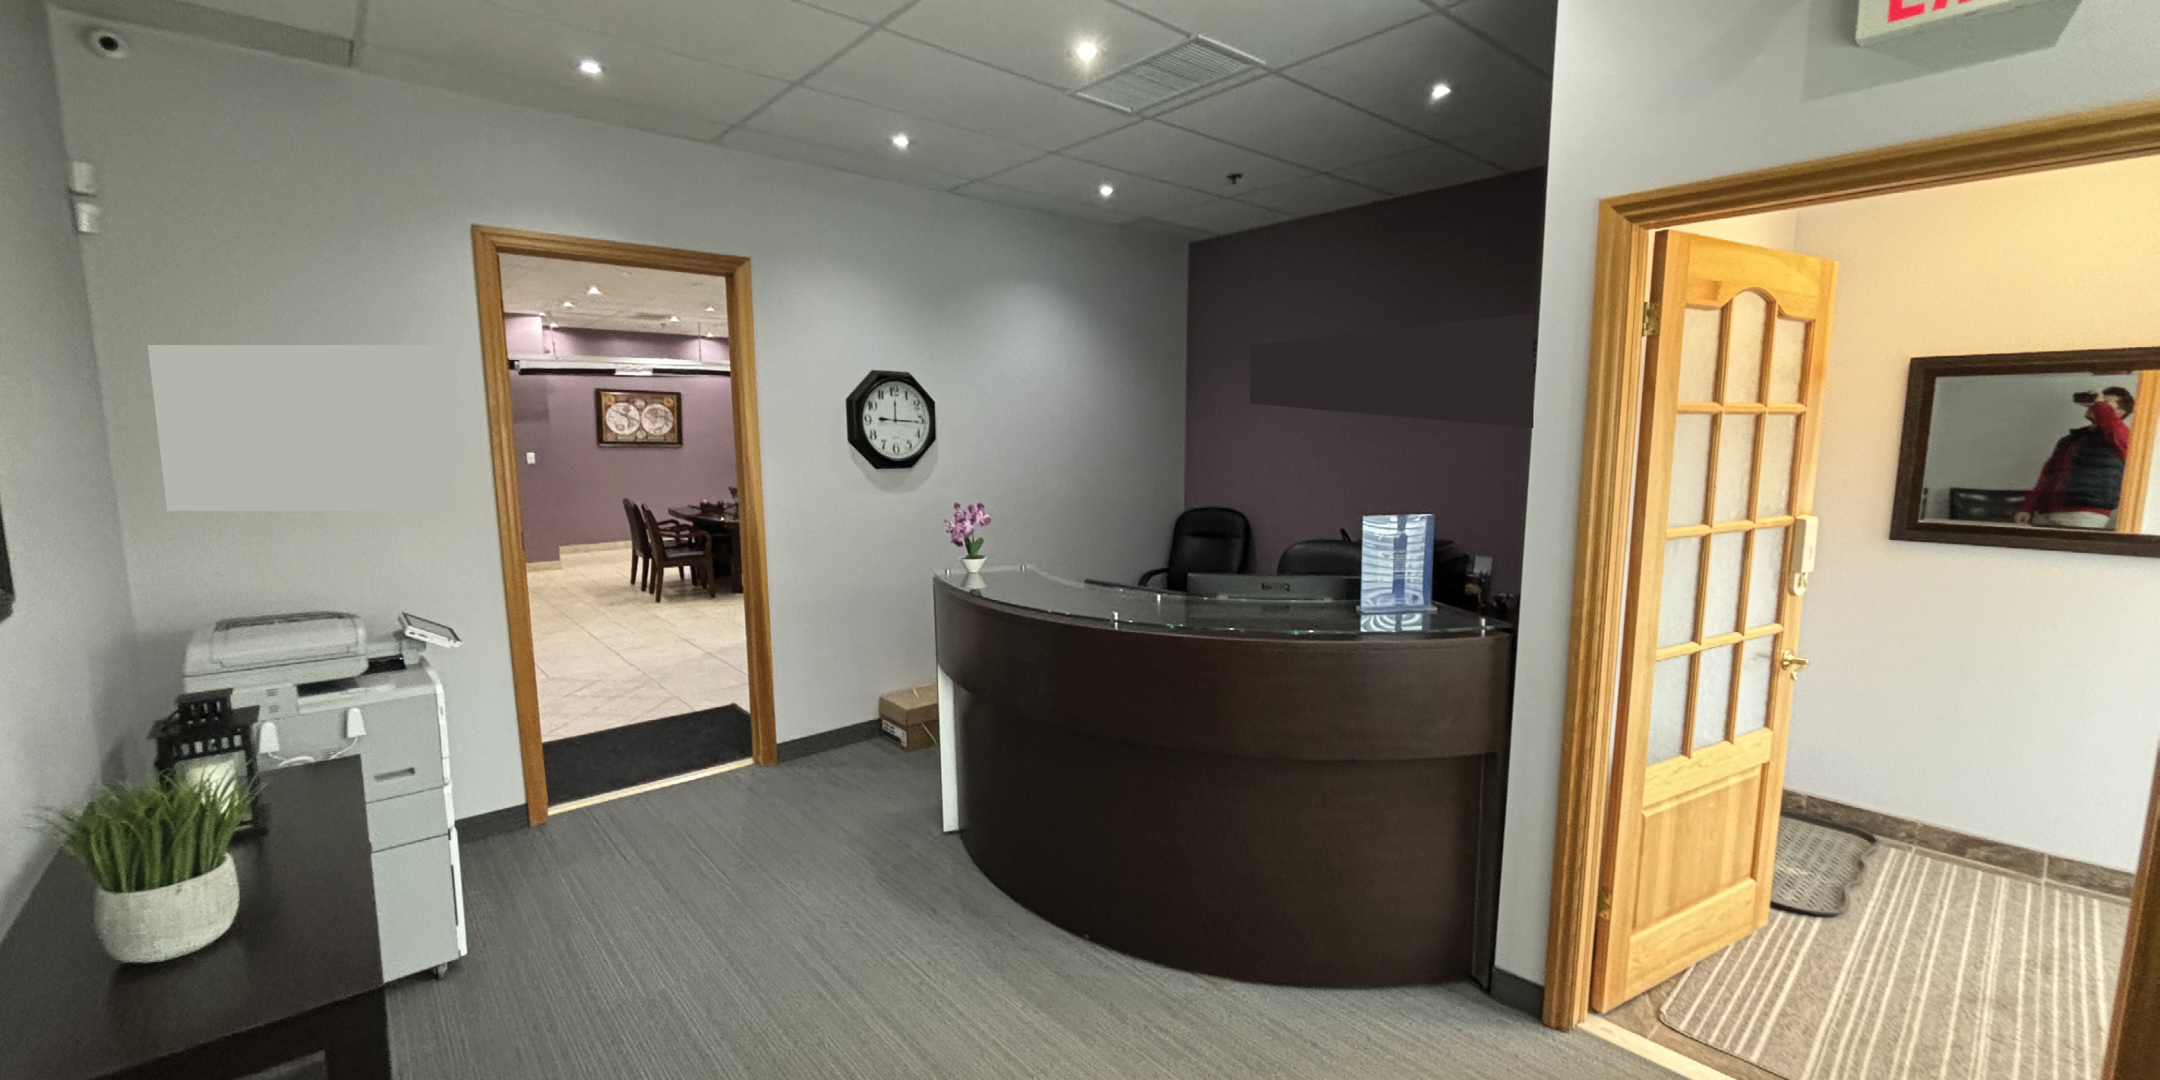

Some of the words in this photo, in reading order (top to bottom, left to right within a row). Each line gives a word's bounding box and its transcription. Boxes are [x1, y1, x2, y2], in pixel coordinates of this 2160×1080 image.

[877, 389, 884, 400] 11
[890, 385, 899, 397] 12
[868, 400, 877, 411] 10
[913, 400, 920, 410] 2
[864, 414, 872, 425] 9
[917, 415, 925, 424] 3
[869, 429, 877, 440] 8
[914, 429, 921, 439] 4
[881, 439, 887, 450] 7
[892, 443, 900, 454] 6
[906, 440, 912, 450] 5
